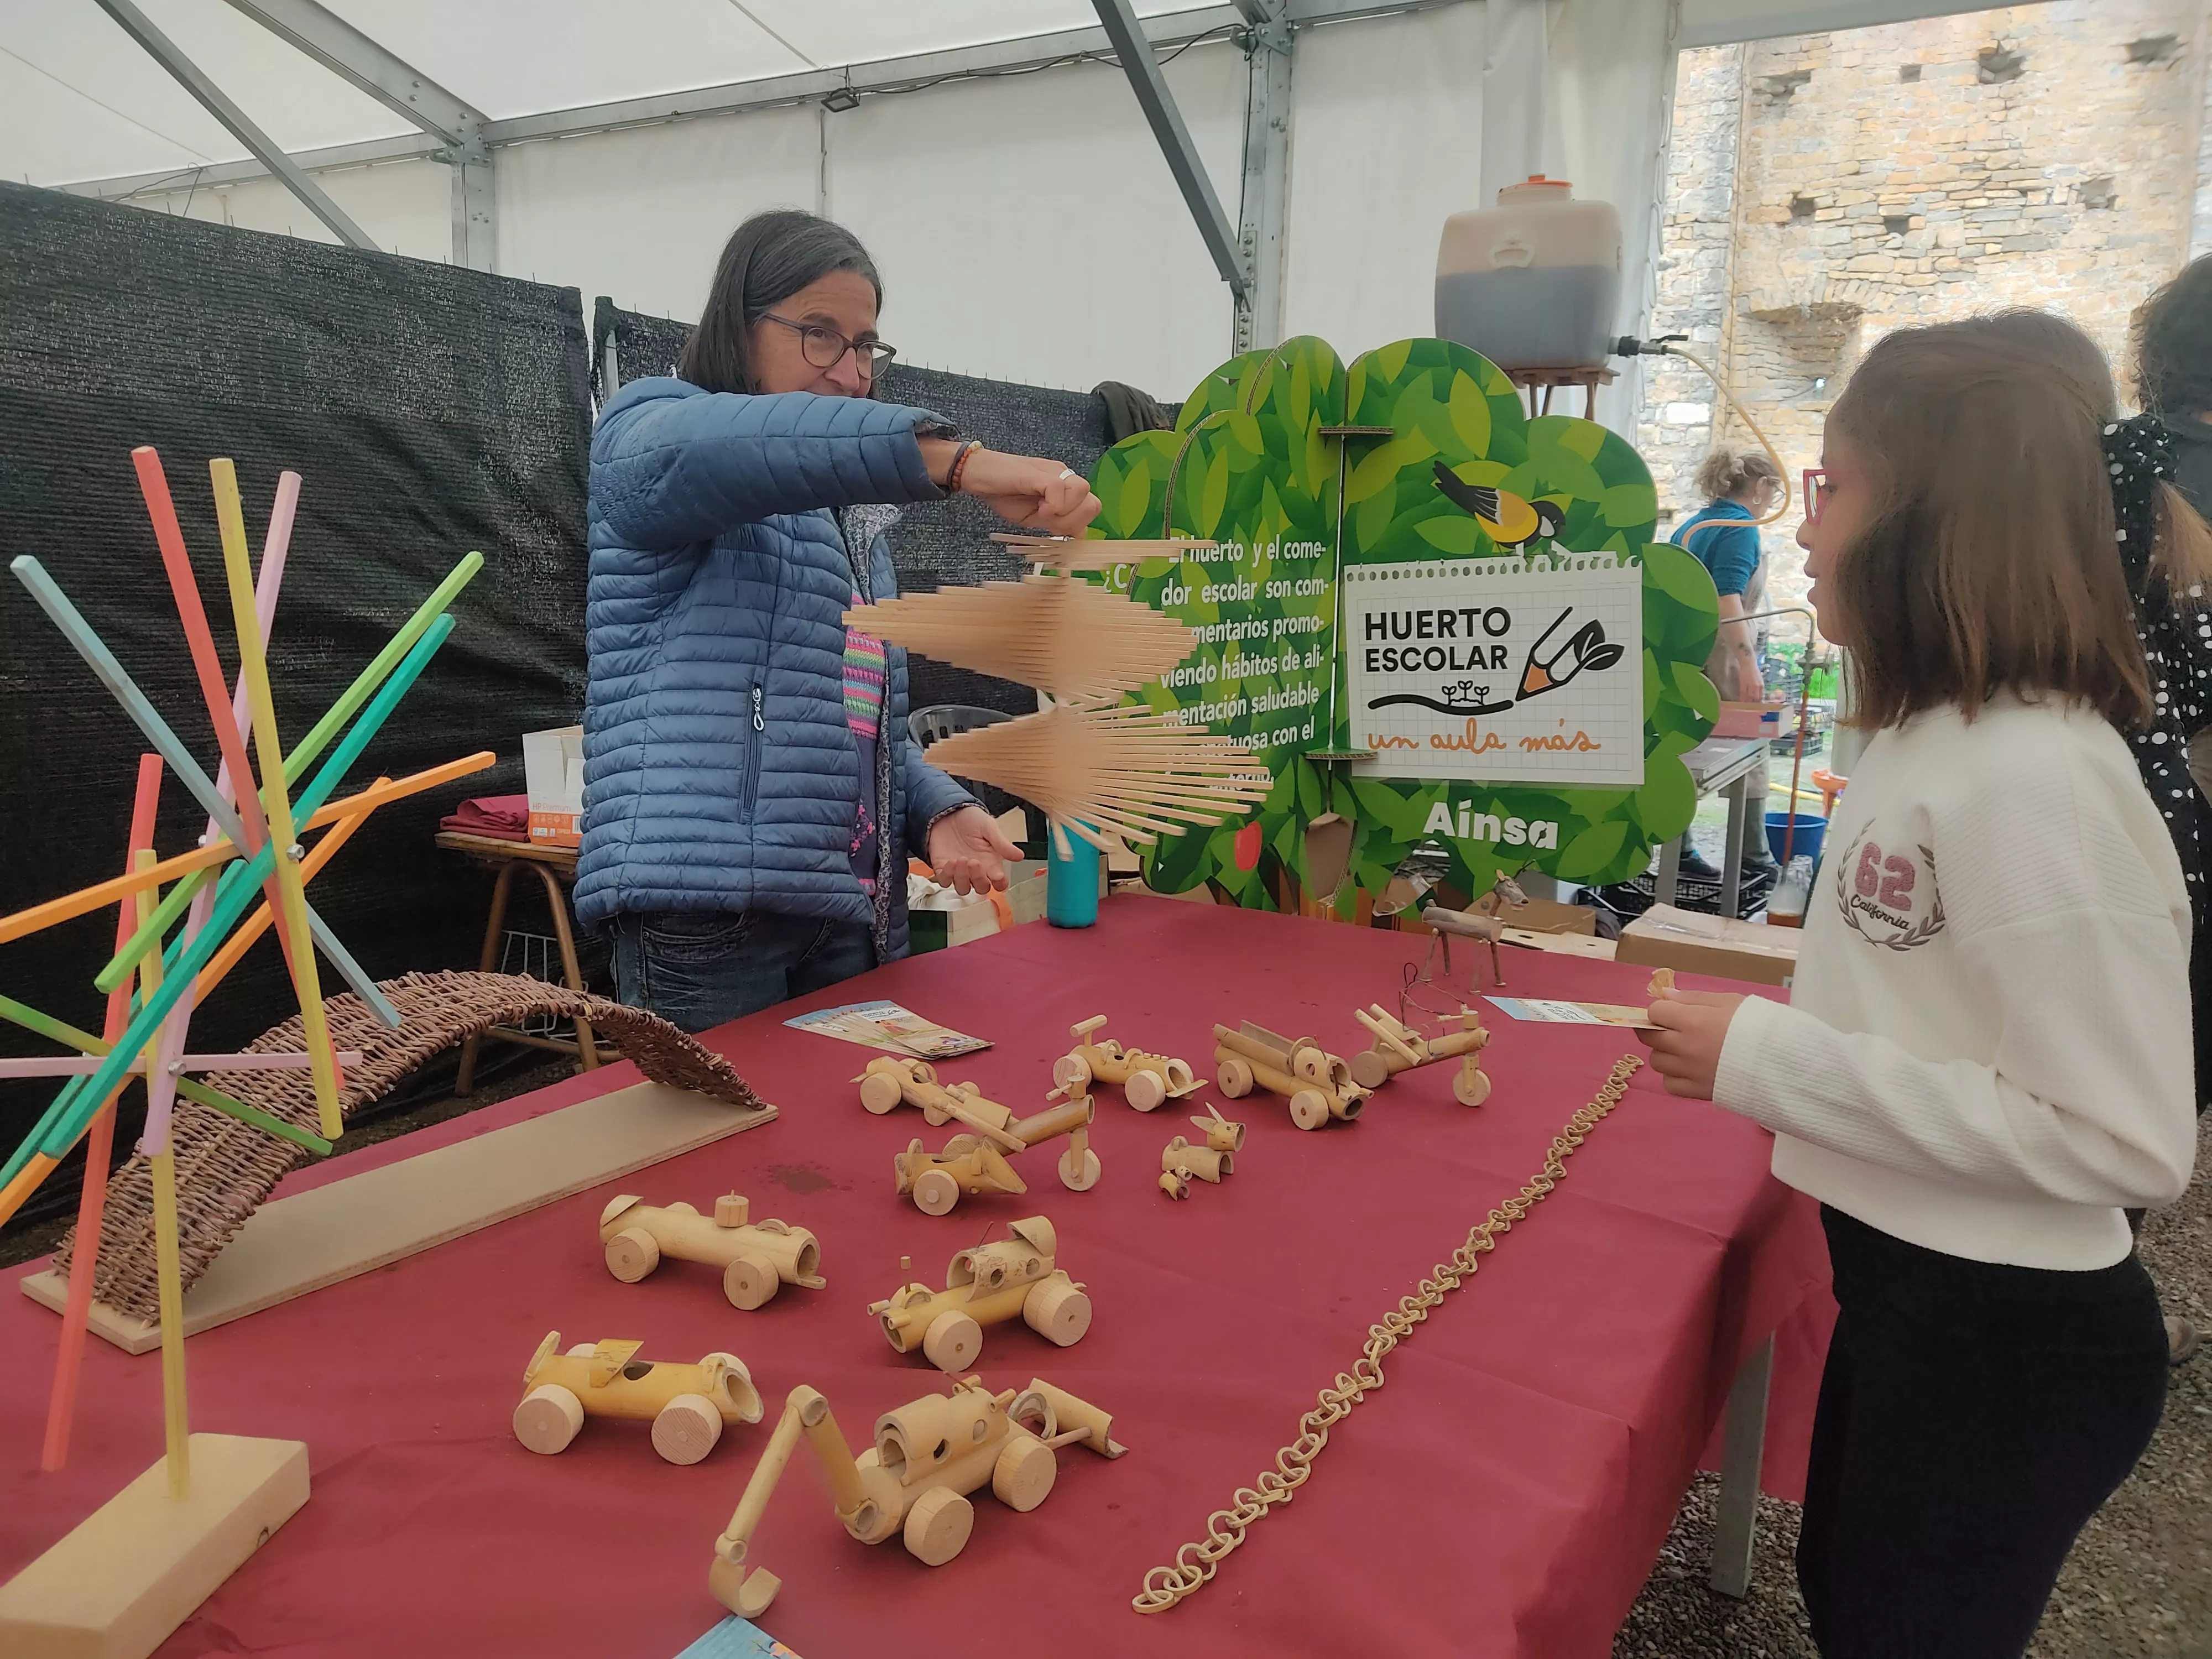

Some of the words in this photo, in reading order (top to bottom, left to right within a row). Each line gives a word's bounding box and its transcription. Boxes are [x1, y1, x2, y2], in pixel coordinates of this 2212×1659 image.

[1190, 535, 1244, 562] huerto
[1252, 542, 1262, 568] y
[1266, 534, 1280, 560] el
[1284, 540, 1327, 559] come-
[1161, 578, 1192, 606] dor
[1201, 575, 1258, 603] escolar
[1265, 580, 1291, 599] son
[1295, 577, 1329, 596] com-
[1272, 614, 1324, 643] promo-
[1365, 607, 1511, 640] HUERTO
[1160, 657, 1217, 688] viendo
[1221, 652, 1278, 681] hábitos
[1281, 646, 1301, 672] de
[1304, 644, 1324, 669] ali-
[1365, 645, 1509, 672] ESCOLAR
[1162, 692, 1247, 728] mentación
[1251, 680, 1320, 716] saludable
[1272, 724, 1298, 747] con
[1301, 715, 1315, 740] el
[1368, 733, 1420, 750] un
[1430, 717, 1507, 754] aula
[1519, 718, 1601, 753] más
[1422, 799, 1559, 851] Aínsa
[1854, 842, 1916, 912] 62
[1850, 894, 1911, 930] California
